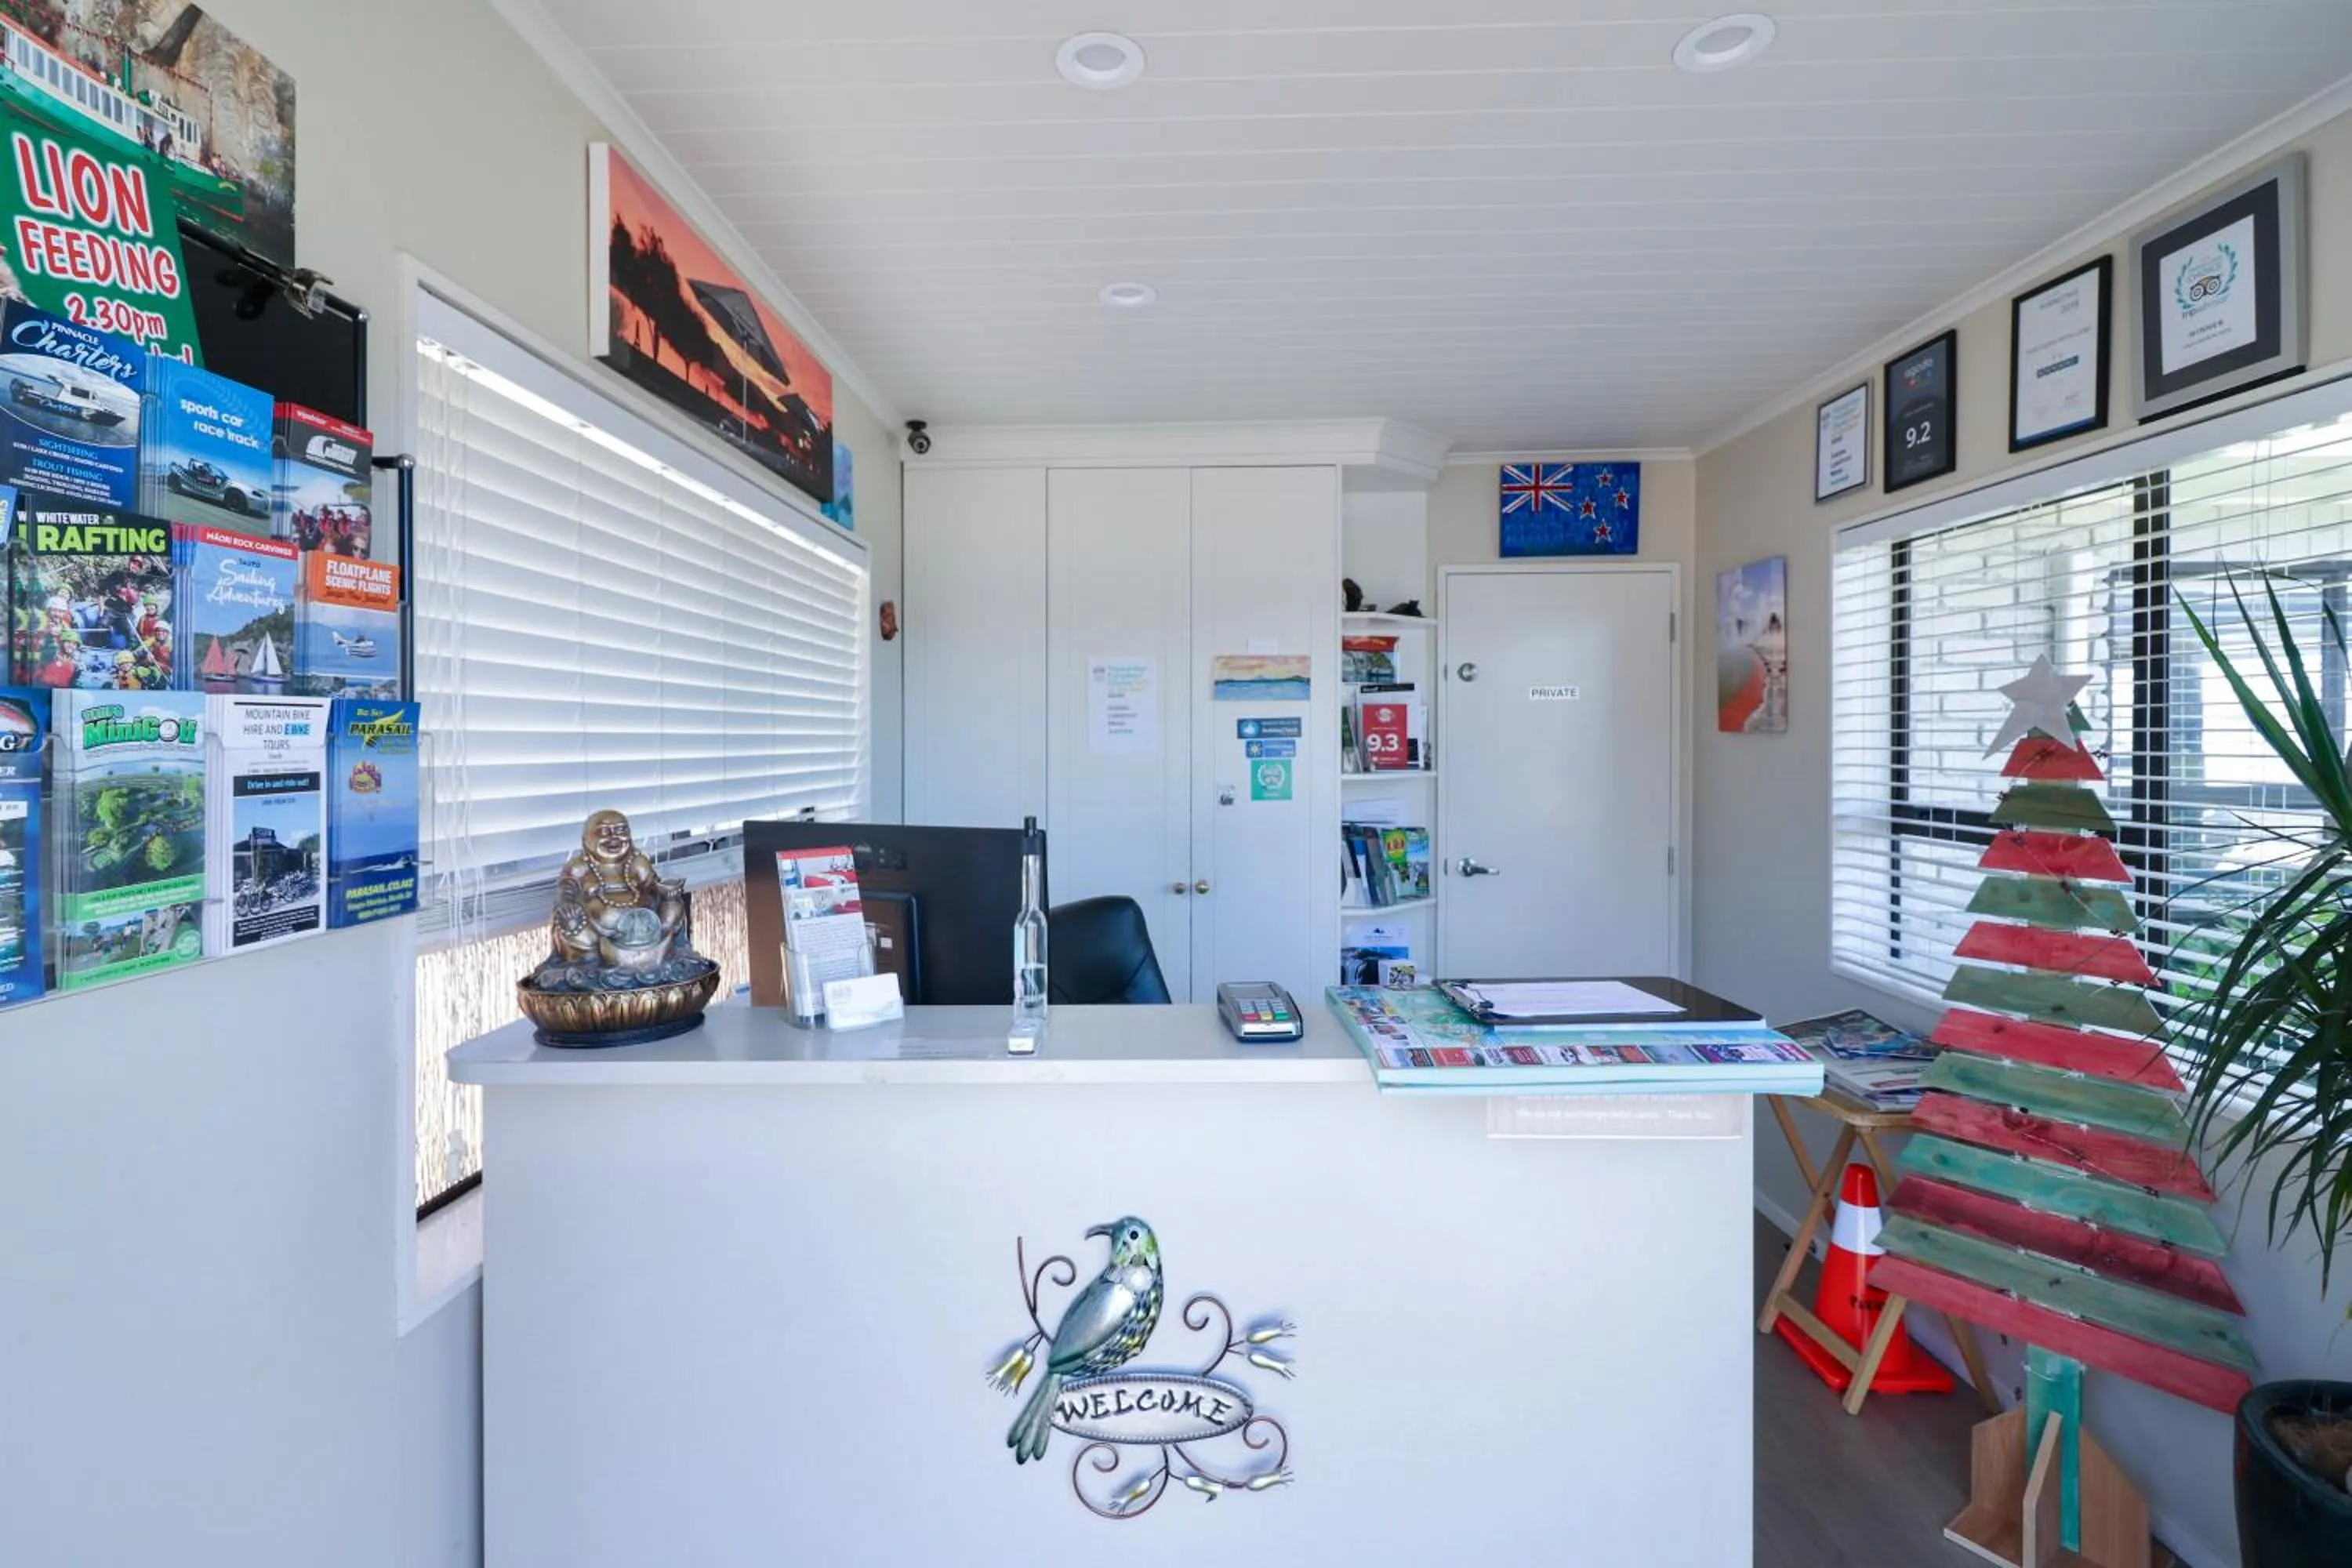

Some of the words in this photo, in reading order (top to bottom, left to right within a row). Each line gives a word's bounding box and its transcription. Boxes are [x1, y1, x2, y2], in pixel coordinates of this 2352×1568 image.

[13, 134, 153, 235] LION
[15, 217, 180, 297] FEEDING
[65, 295, 166, 345] 2.30pm
[51, 322, 100, 345] PINNACLE
[11, 319, 137, 380] Charters
[180, 398, 219, 421] sports
[222, 412, 245, 427] car
[194, 420, 225, 438] race
[227, 428, 260, 450] track
[1906, 420, 1931, 449] 9.2
[36, 512, 100, 524] WHITEWATER
[38, 524, 166, 553] RAFTING
[233, 538, 254, 550] ROCK
[254, 541, 293, 556] CARVINGS
[216, 557, 277, 593] Sailing
[326, 560, 393, 584] FLOATPLANE
[325, 575, 357, 590] SCENIC
[358, 579, 392, 596] FLIGHTS
[206, 586, 286, 615] Adventures
[1531, 688, 1578, 699] PRIVATE
[245, 709, 291, 720] MOUNTAIN
[292, 709, 311, 720] BIKE
[243, 724, 264, 735] HIRE
[264, 724, 283, 735] AND
[349, 722, 413, 735] PARASAIL
[263, 739, 290, 750] TOURS
[1367, 733, 1400, 753] 9.3
[1055, 1388, 1233, 1426] WELCOME
